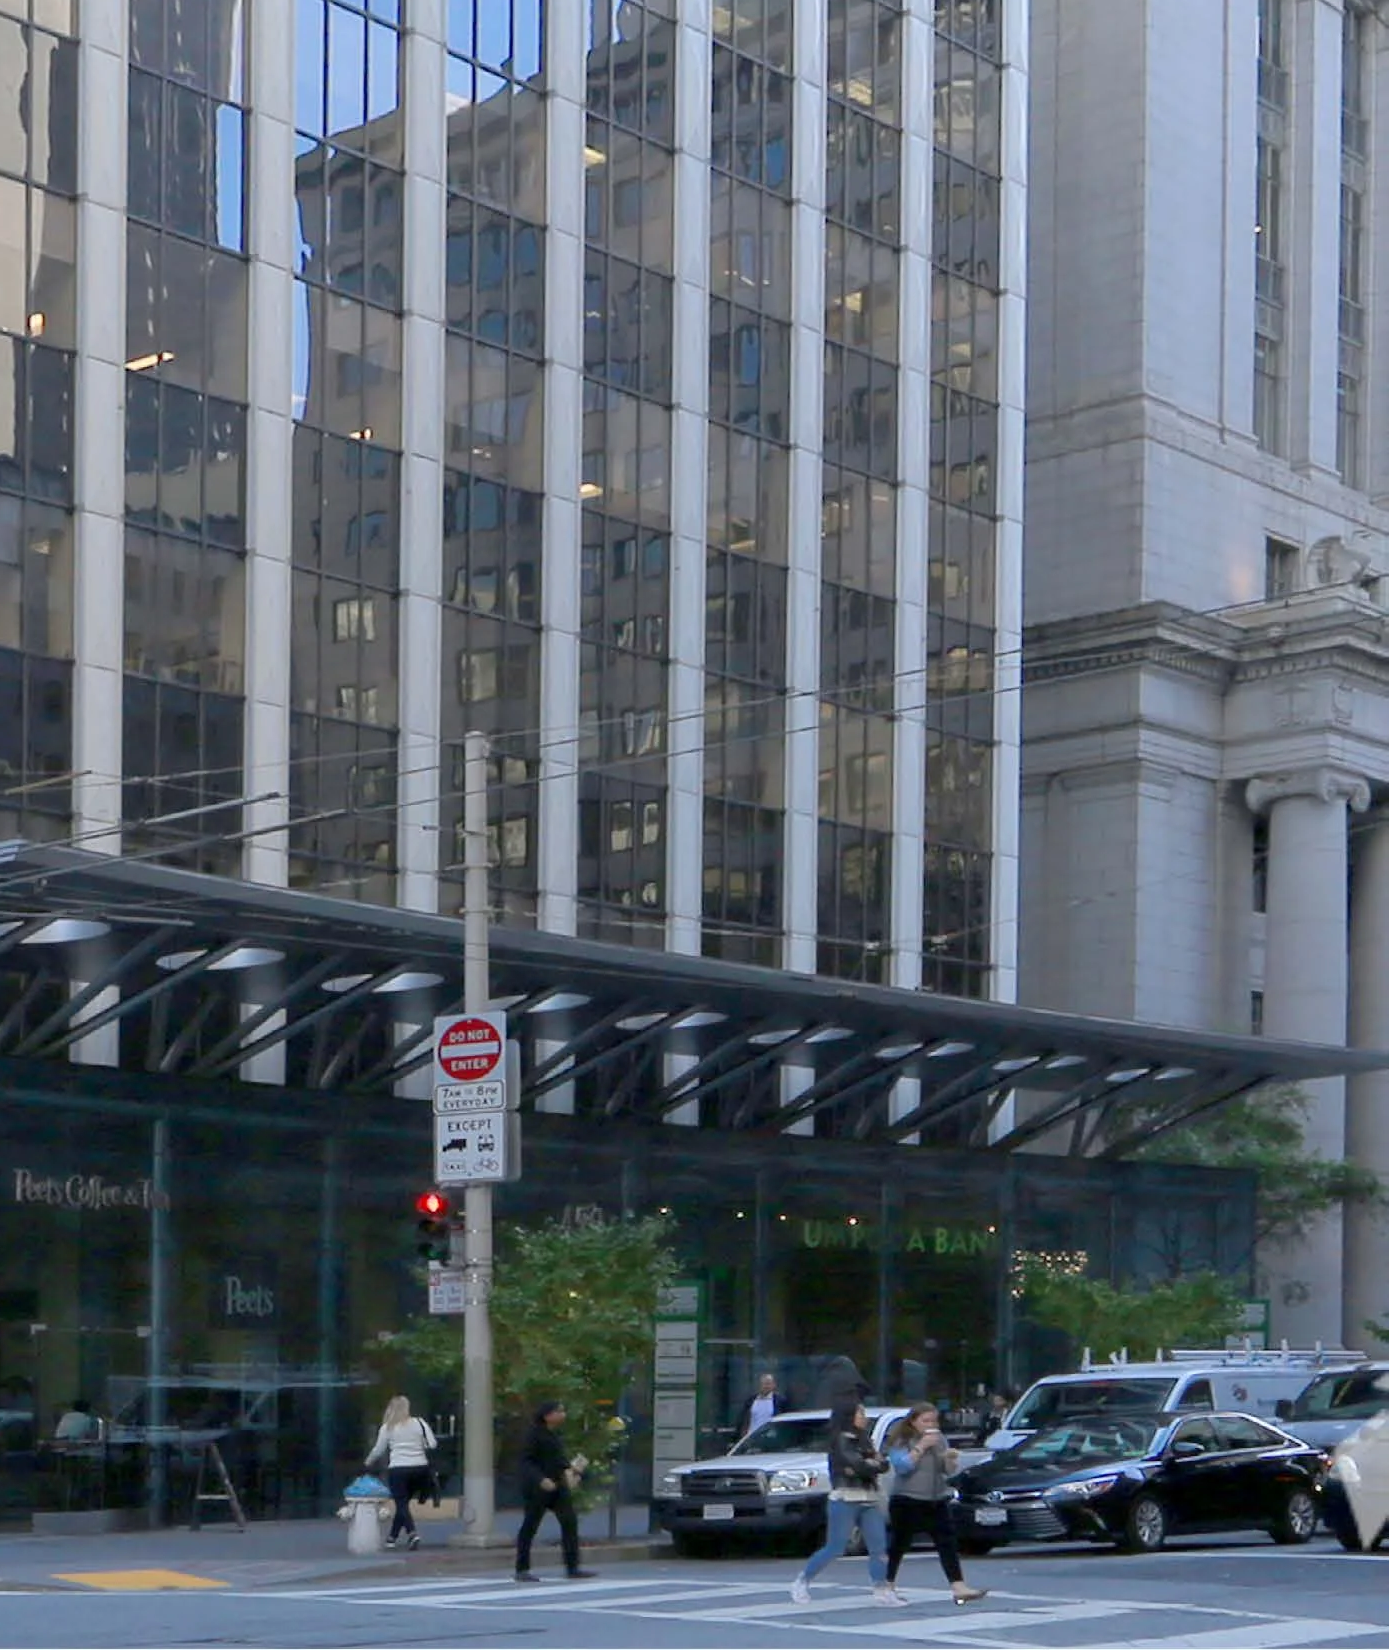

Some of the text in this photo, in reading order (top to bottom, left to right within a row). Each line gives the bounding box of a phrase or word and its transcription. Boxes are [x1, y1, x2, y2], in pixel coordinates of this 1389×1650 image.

[449, 1028, 491, 1043] DO NOT
[451, 1057, 489, 1071] ENTER
[443, 1097, 495, 1109] EVERYDAY
[448, 1119, 492, 1133] EXCEPT
[65, 1174, 122, 1210] Coffee
